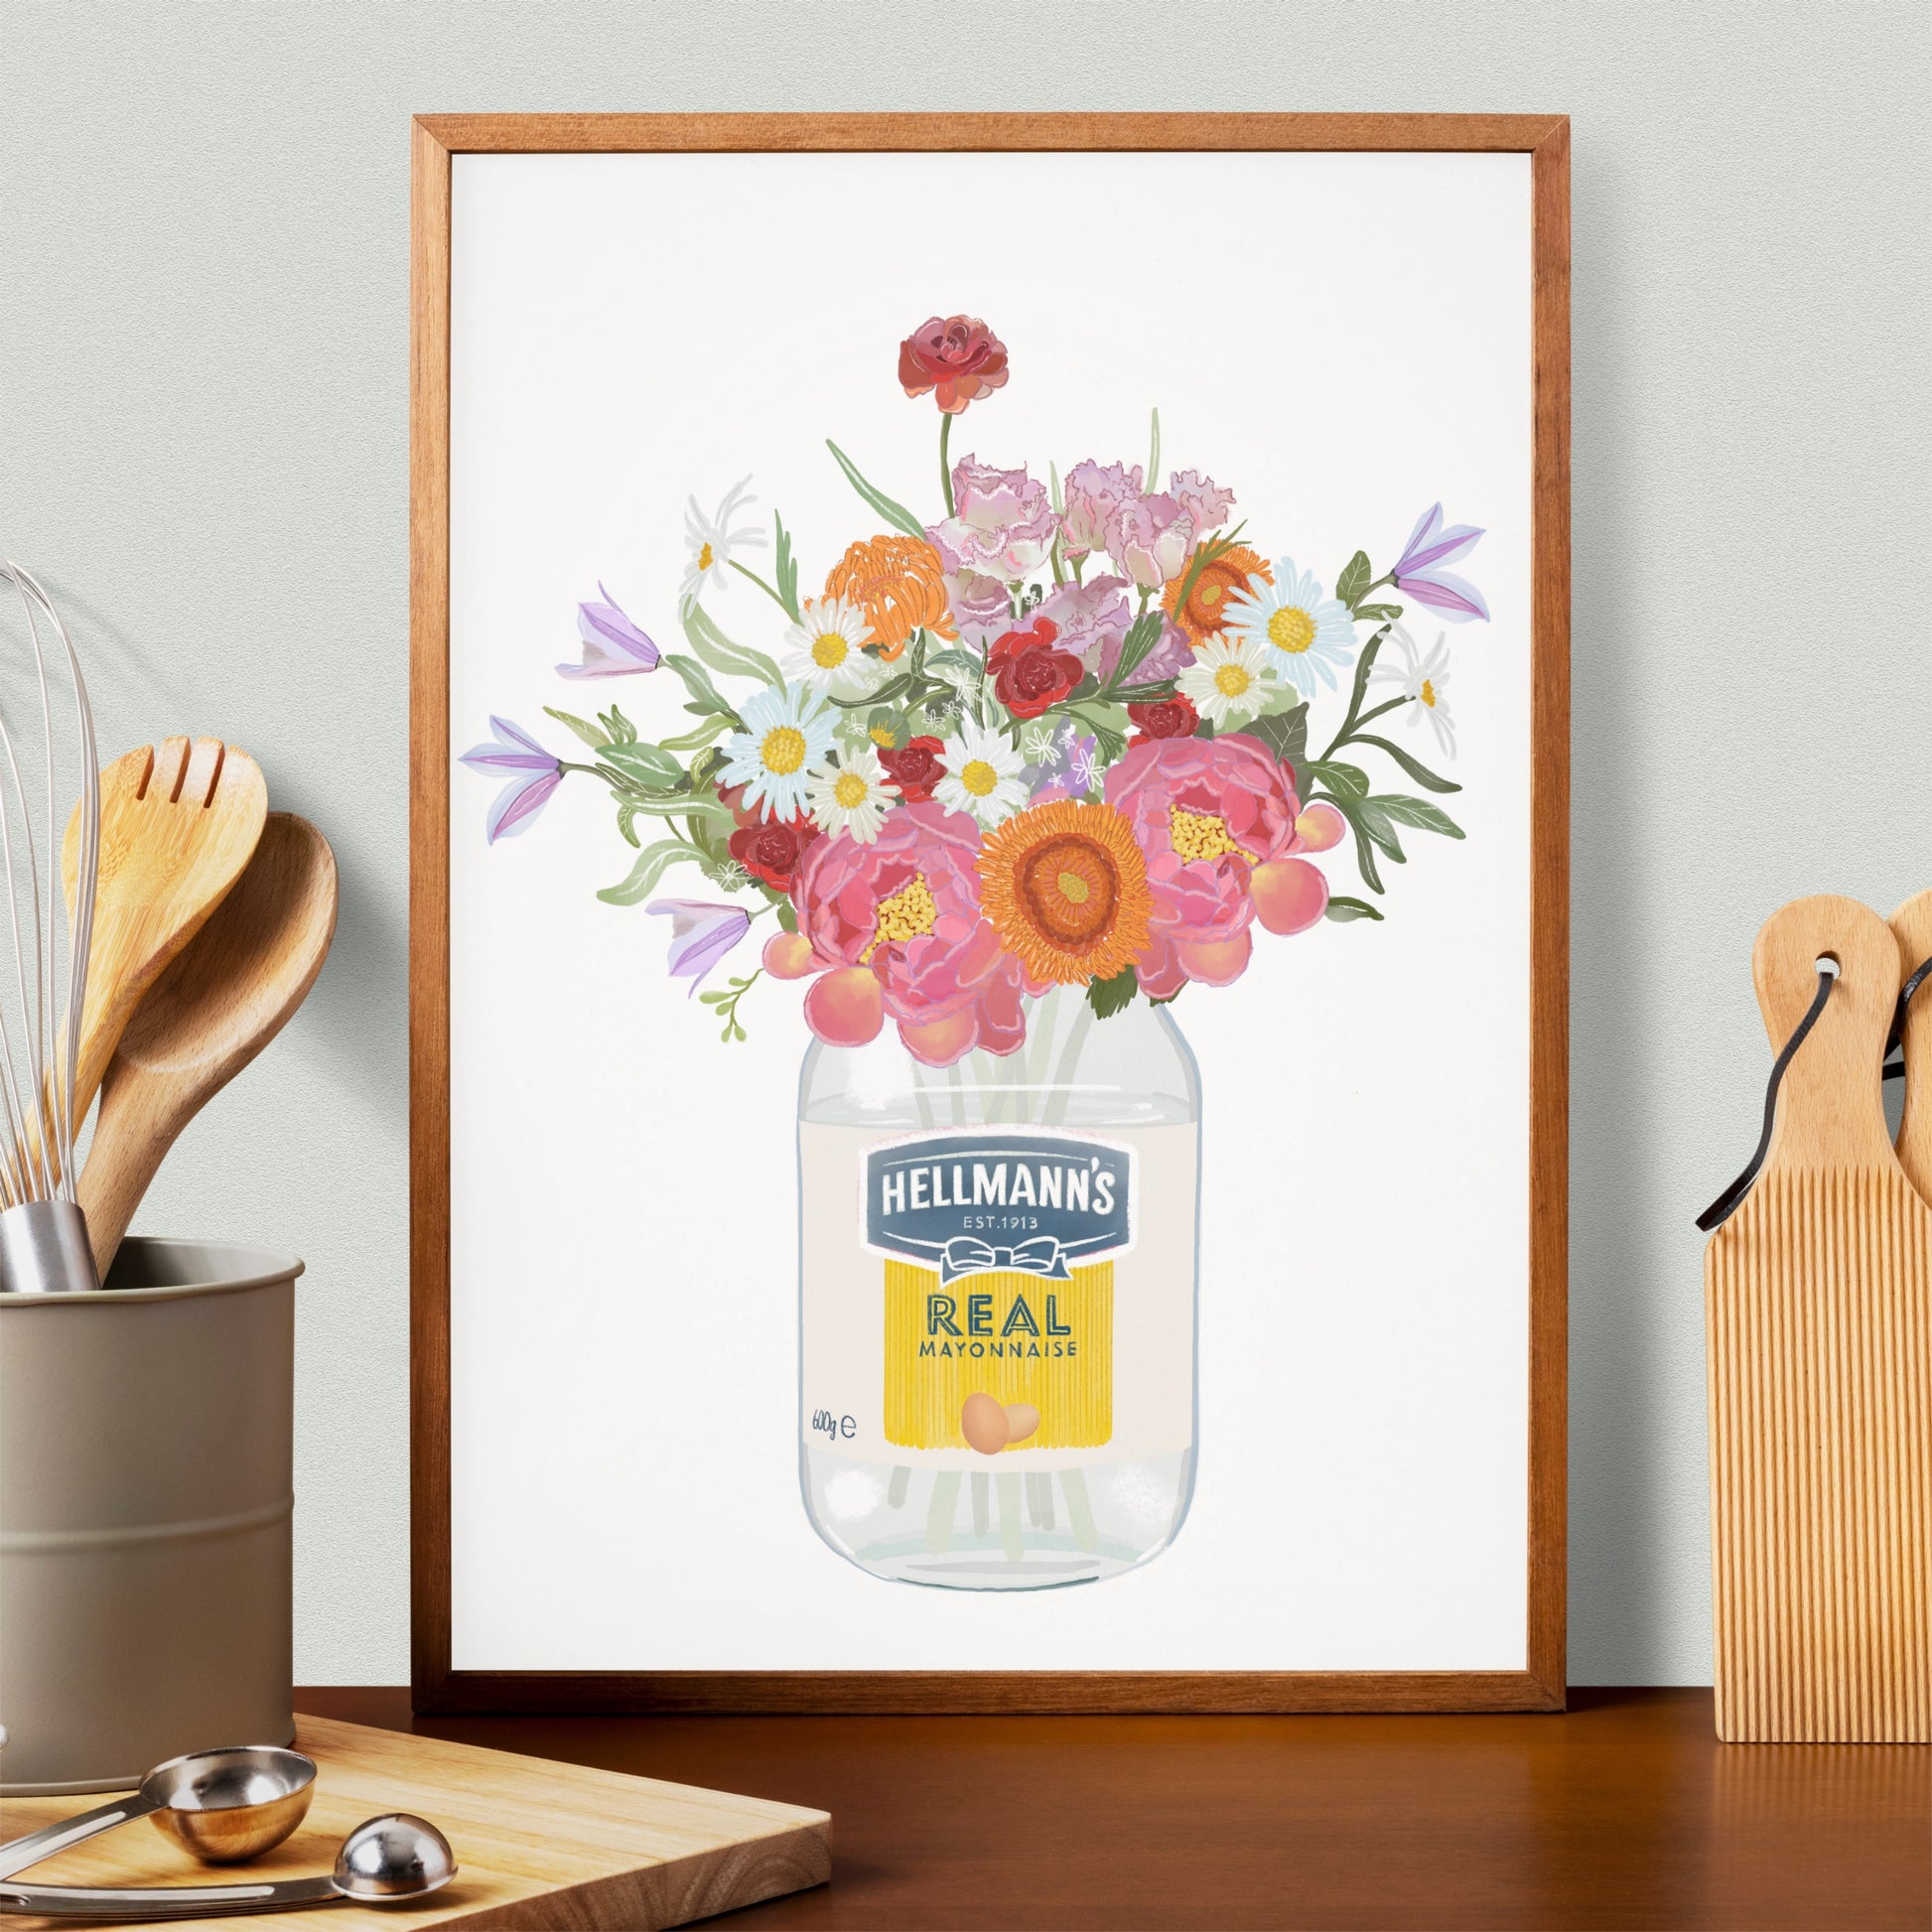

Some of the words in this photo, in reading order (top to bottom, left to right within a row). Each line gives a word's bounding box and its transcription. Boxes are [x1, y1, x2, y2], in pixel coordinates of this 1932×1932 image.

[882, 1157, 1117, 1215] HELLMANN'S
[927, 1294, 1072, 1337] REAL
[918, 1340, 1078, 1358] MAYONNAISE
